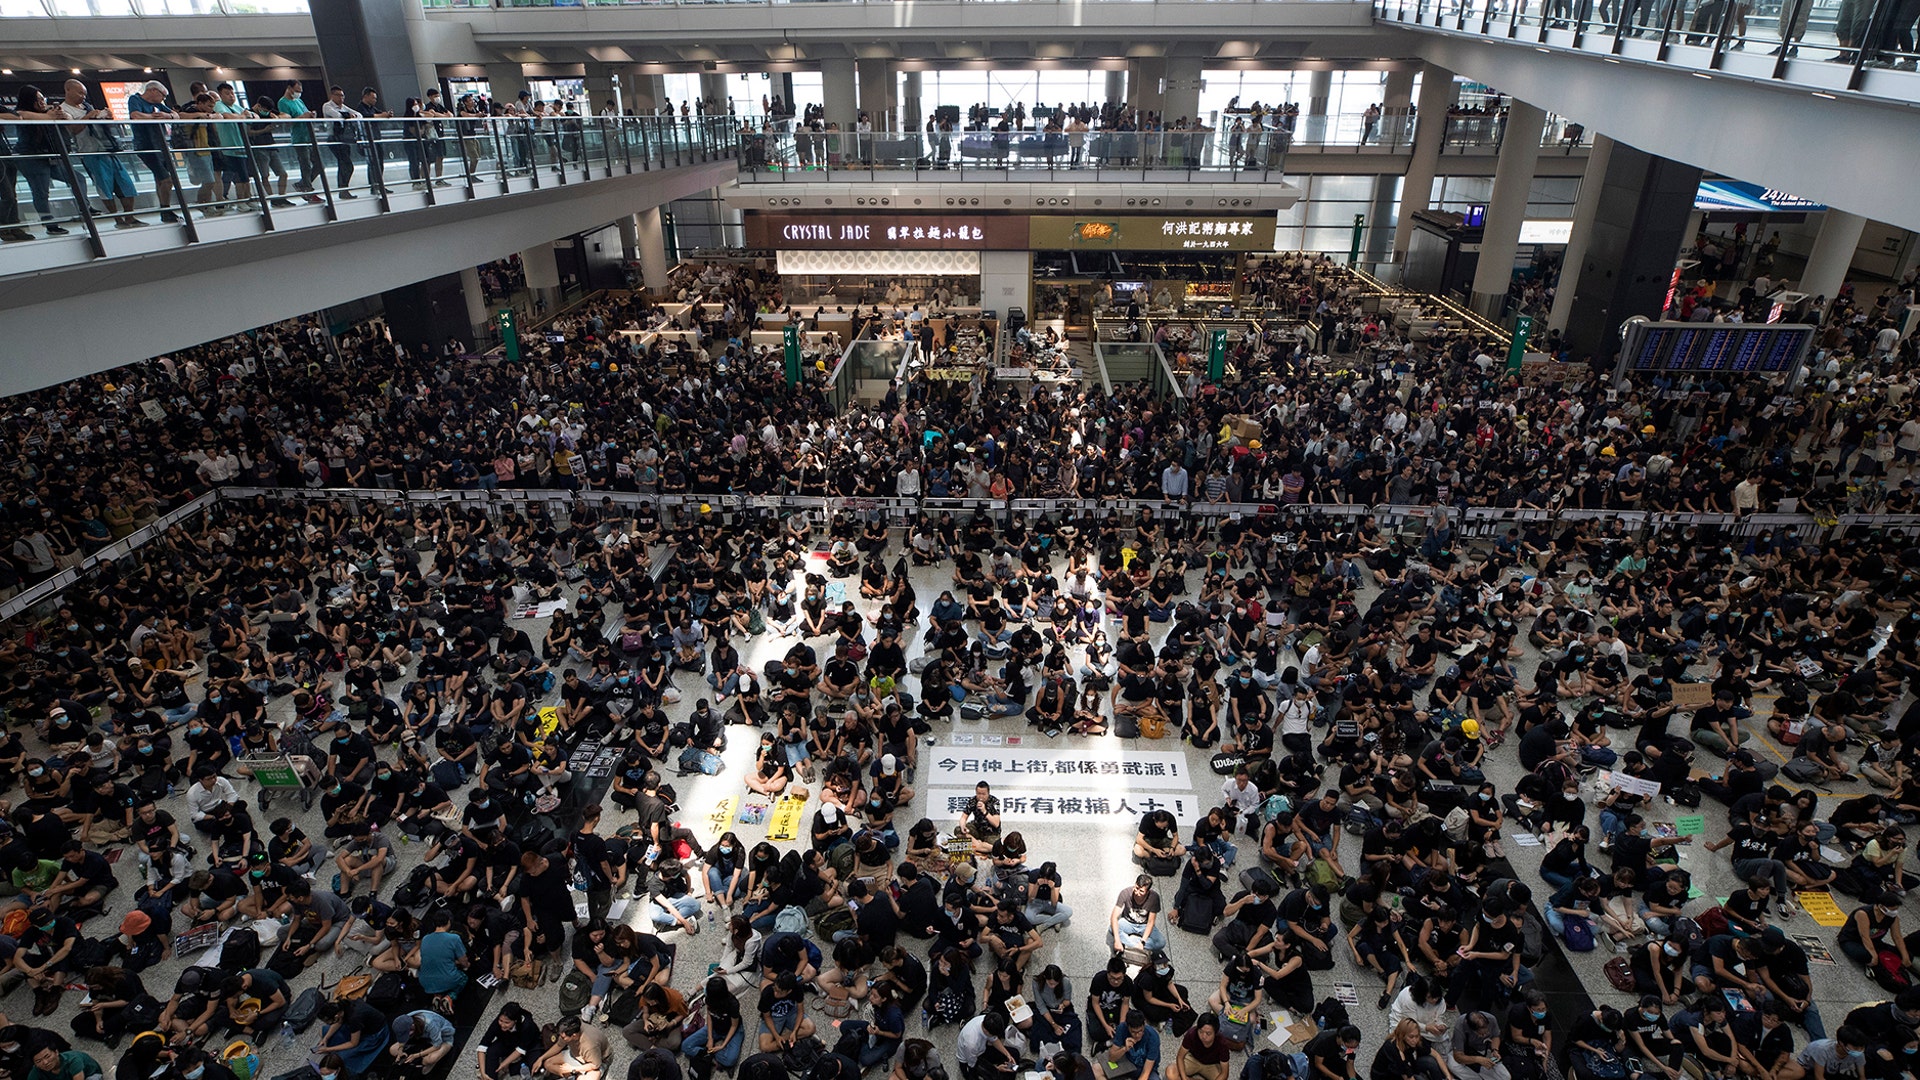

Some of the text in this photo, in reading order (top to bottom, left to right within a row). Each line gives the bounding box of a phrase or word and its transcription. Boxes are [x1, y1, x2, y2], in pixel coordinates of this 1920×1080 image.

[783, 225, 870, 240] CRYSTAL JADE
[1213, 756, 1246, 769] Wilson
[947, 796, 1184, 817] 釋所有被捕人士!
